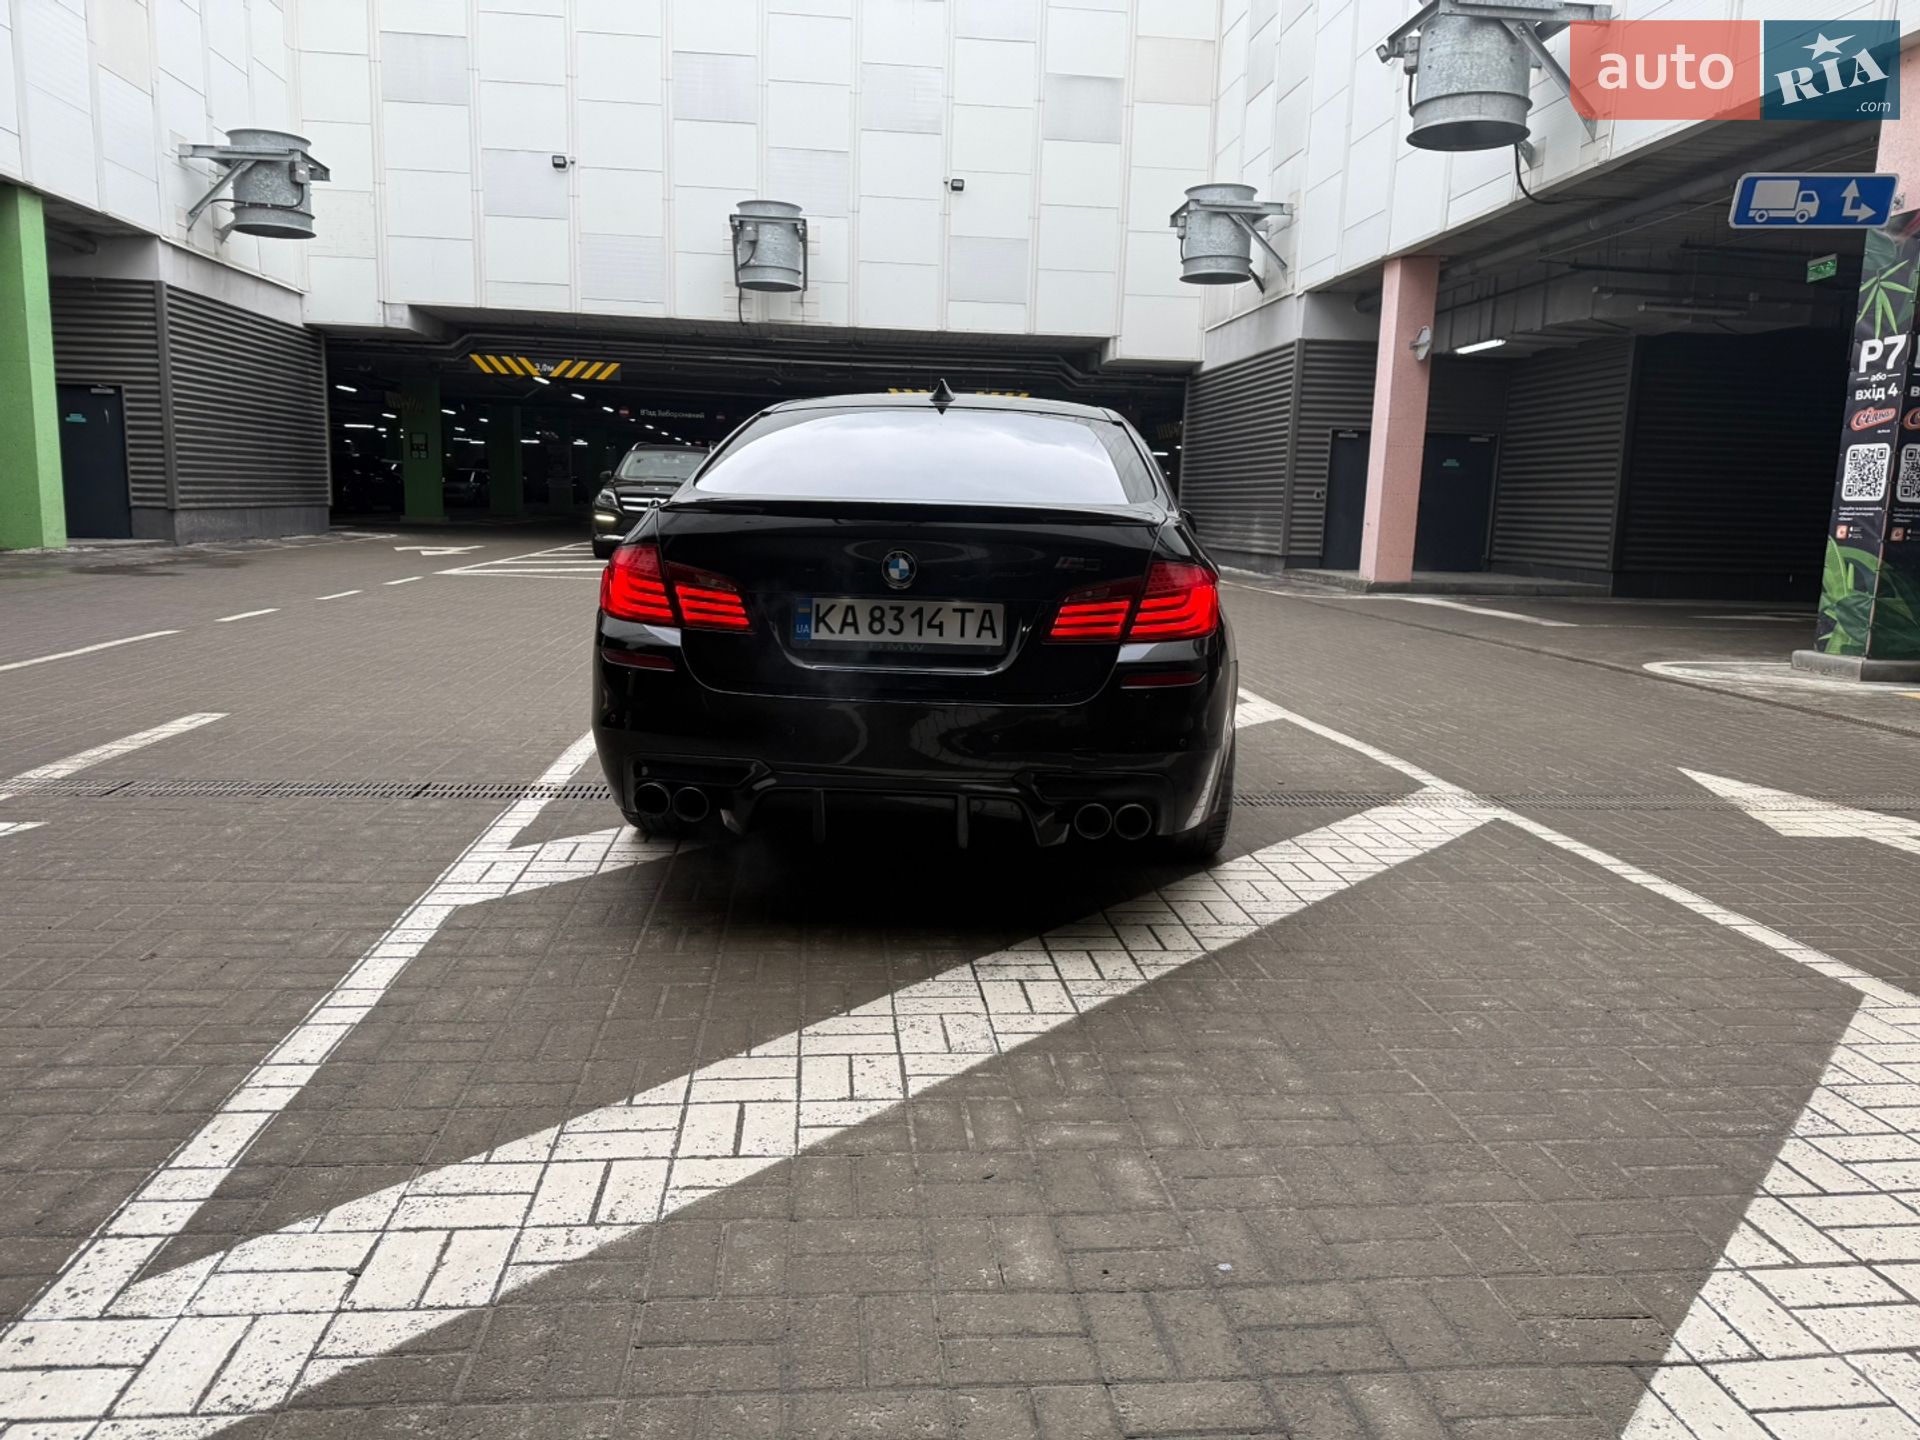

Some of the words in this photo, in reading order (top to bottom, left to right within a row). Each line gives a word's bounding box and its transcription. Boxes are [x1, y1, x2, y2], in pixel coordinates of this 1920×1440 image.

[1859, 334, 1907, 373] P7
[1855, 384, 1885, 401] вхід
[1887, 382, 1899, 397] 4
[796, 624, 810, 634] UA
[814, 604, 860, 634] KA
[868, 606, 944, 637] 8314
[952, 608, 997, 639] TA
